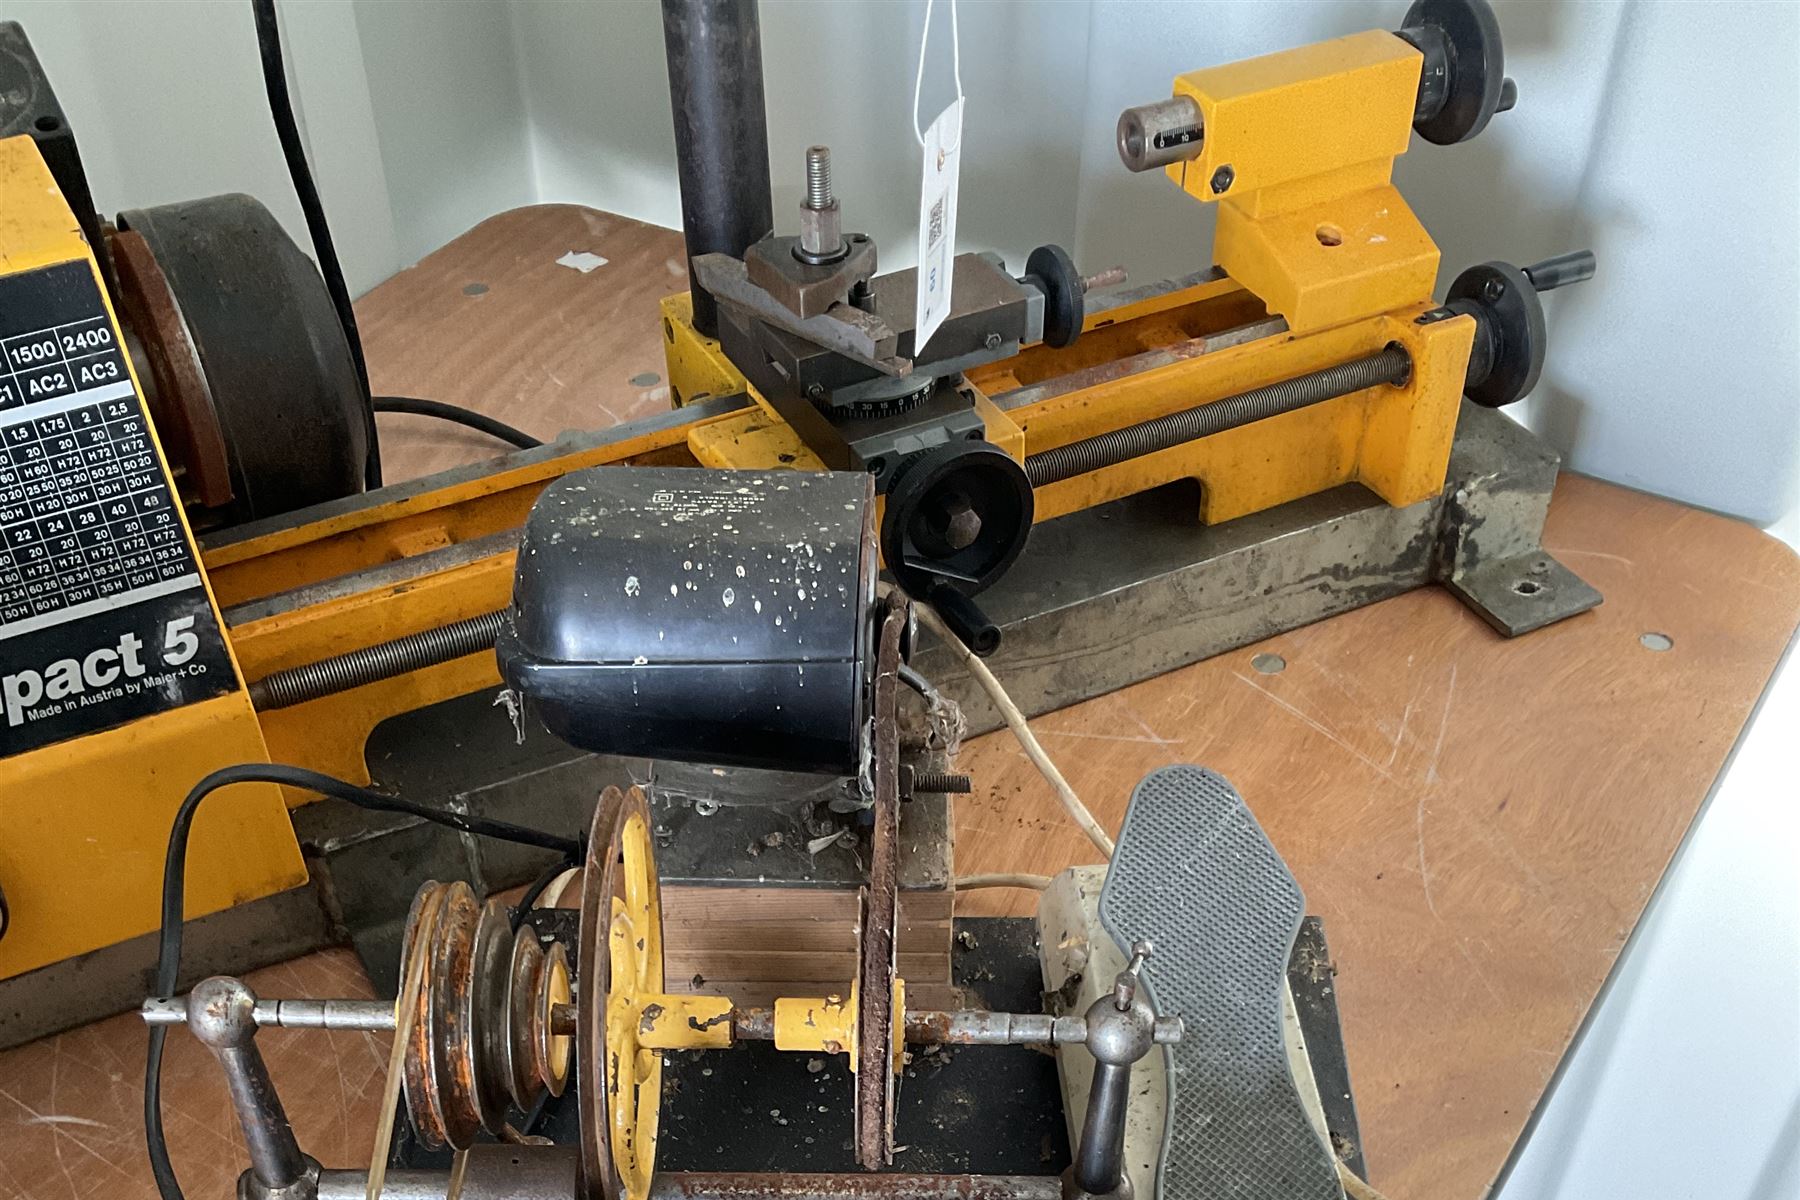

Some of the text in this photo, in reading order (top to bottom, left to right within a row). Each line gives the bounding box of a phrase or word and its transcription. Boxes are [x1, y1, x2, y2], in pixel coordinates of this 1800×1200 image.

[10, 328, 110, 364] 1500 2400
[30, 374, 68, 396] AC2
[82, 361, 118, 383] AC3
[11, 403, 128, 440] 1,5 1,75 2 2,5
[26, 446, 40, 458] 20
[59, 439, 73, 450] 20
[91, 430, 105, 441] 20
[123, 422, 138, 433] 20
[8, 489, 22, 500] 20
[27, 484, 40, 496] 25
[41, 480, 55, 492] 50
[59, 477, 73, 487] 35
[73, 472, 87, 483] 20
[91, 468, 105, 479] 50
[106, 464, 119, 475] 25
[123, 460, 137, 471] 50
[138, 456, 152, 467] 20
[24, 468, 33, 478] H
[34, 464, 48, 475] 60
[57, 459, 66, 469] H
[67, 456, 81, 466] 72
[88, 451, 97, 461] H
[97, 448, 111, 458] 72
[122, 443, 130, 452] H
[131, 440, 144, 450] 72
[0, 474, 152, 521] 60 H H 20 30 H 30 H 30 H
[15, 496, 159, 542] 22 24 28 40 48
[5, 573, 19, 583] 60
[27, 568, 36, 577] H
[36, 564, 50, 574] 72
[59, 559, 67, 568] H
[68, 555, 82, 565] 72
[91, 550, 100, 559] H
[100, 546, 114, 556] 72
[123, 542, 131, 551] H
[132, 538, 146, 548] 72
[154, 533, 162, 542] H
[163, 530, 176, 540] 72
[29, 547, 43, 558] 20
[61, 538, 74, 549] 20
[94, 530, 108, 540] 20
[125, 522, 138, 532] 20
[156, 513, 170, 524] 20
[5, 564, 184, 619] 50 H 60 H 30 H 35 H 50 H 60 H
[12, 589, 25, 599] 34
[29, 584, 43, 594] 60
[44, 580, 58, 590] 26
[62, 575, 75, 586] 36
[76, 571, 89, 581] 34
[94, 567, 107, 577] 36
[108, 562, 120, 573] 34
[124, 558, 137, 568] 36
[138, 555, 151, 565] 34
[156, 550, 169, 560] 36
[170, 546, 183, 556] 34
[0, 615, 199, 727] pact 5
[27, 704, 62, 722] Made
[64, 700, 77, 712] in
[80, 684, 124, 708] Austria
[125, 682, 141, 694] by
